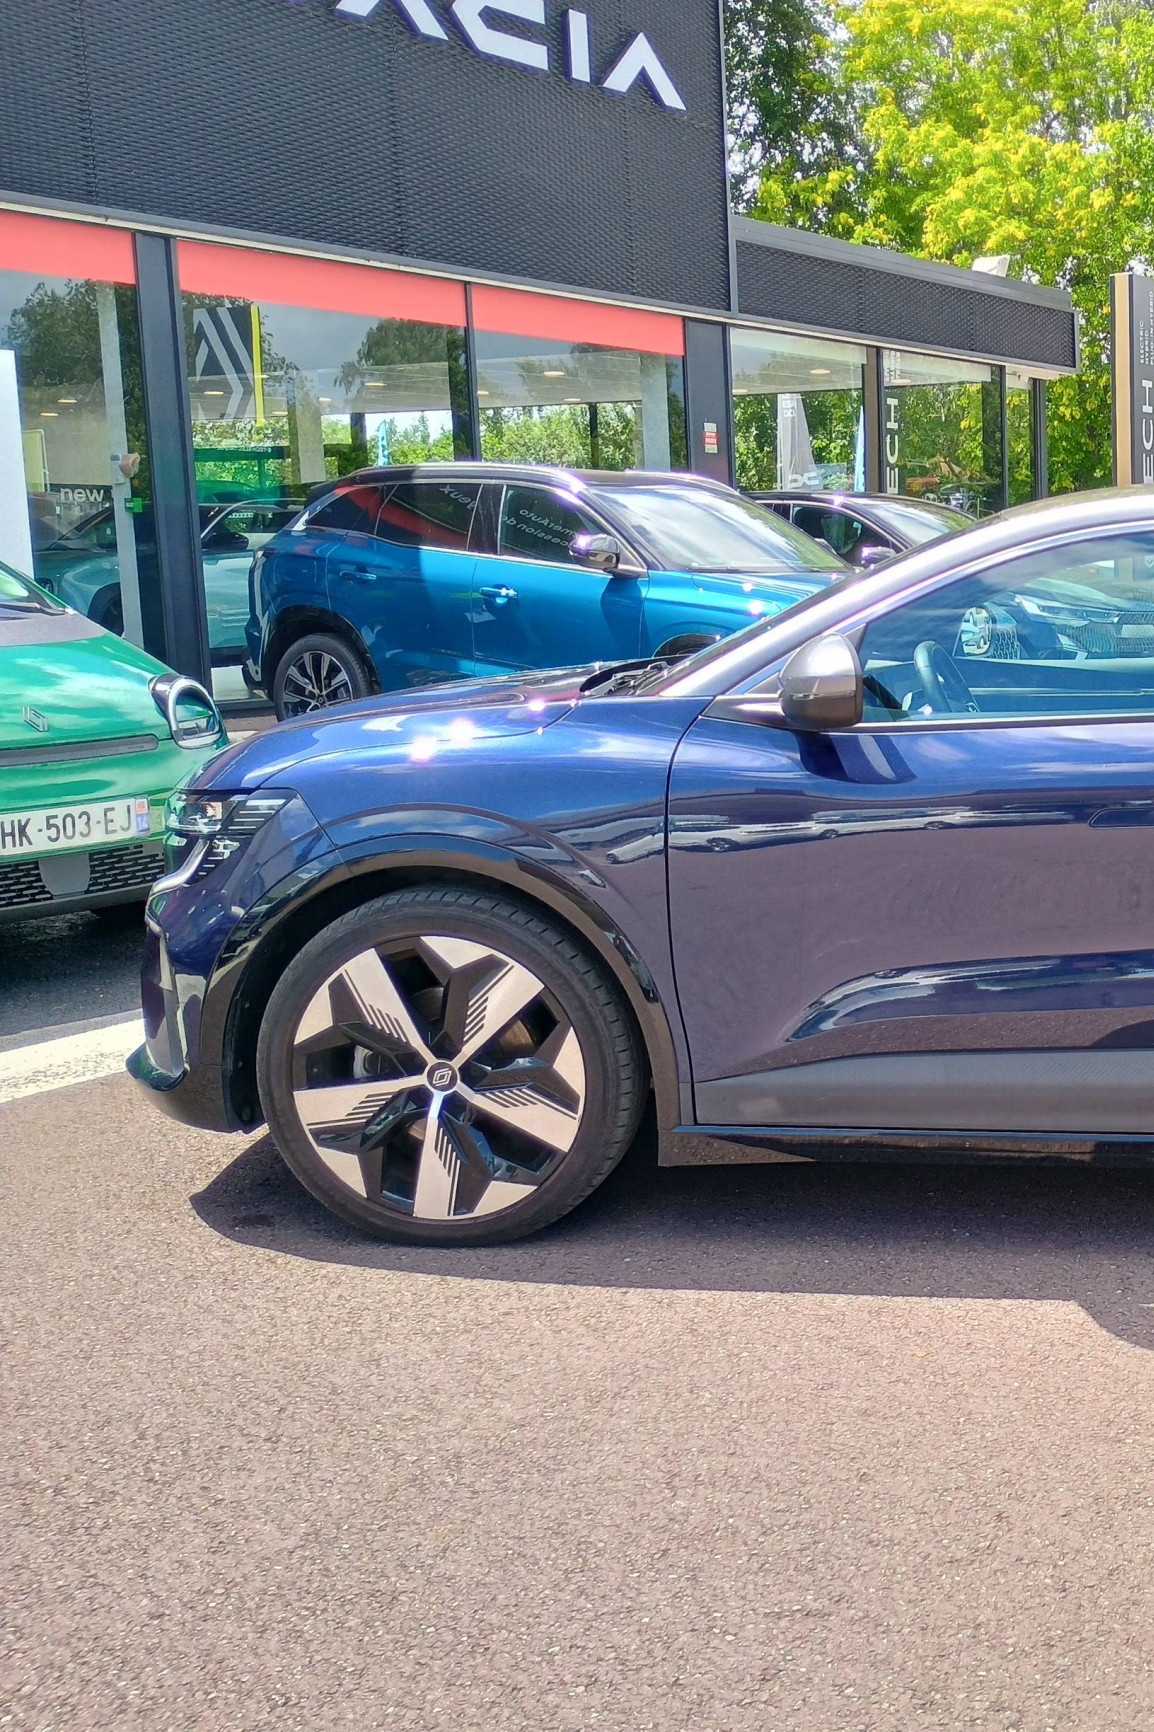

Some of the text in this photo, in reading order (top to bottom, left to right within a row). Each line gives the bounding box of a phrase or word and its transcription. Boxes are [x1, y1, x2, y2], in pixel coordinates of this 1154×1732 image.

[1141, 379, 1154, 485] ECH
[60, 487, 104, 503] new
[0, 804, 132, 850] HK-503-EJ
